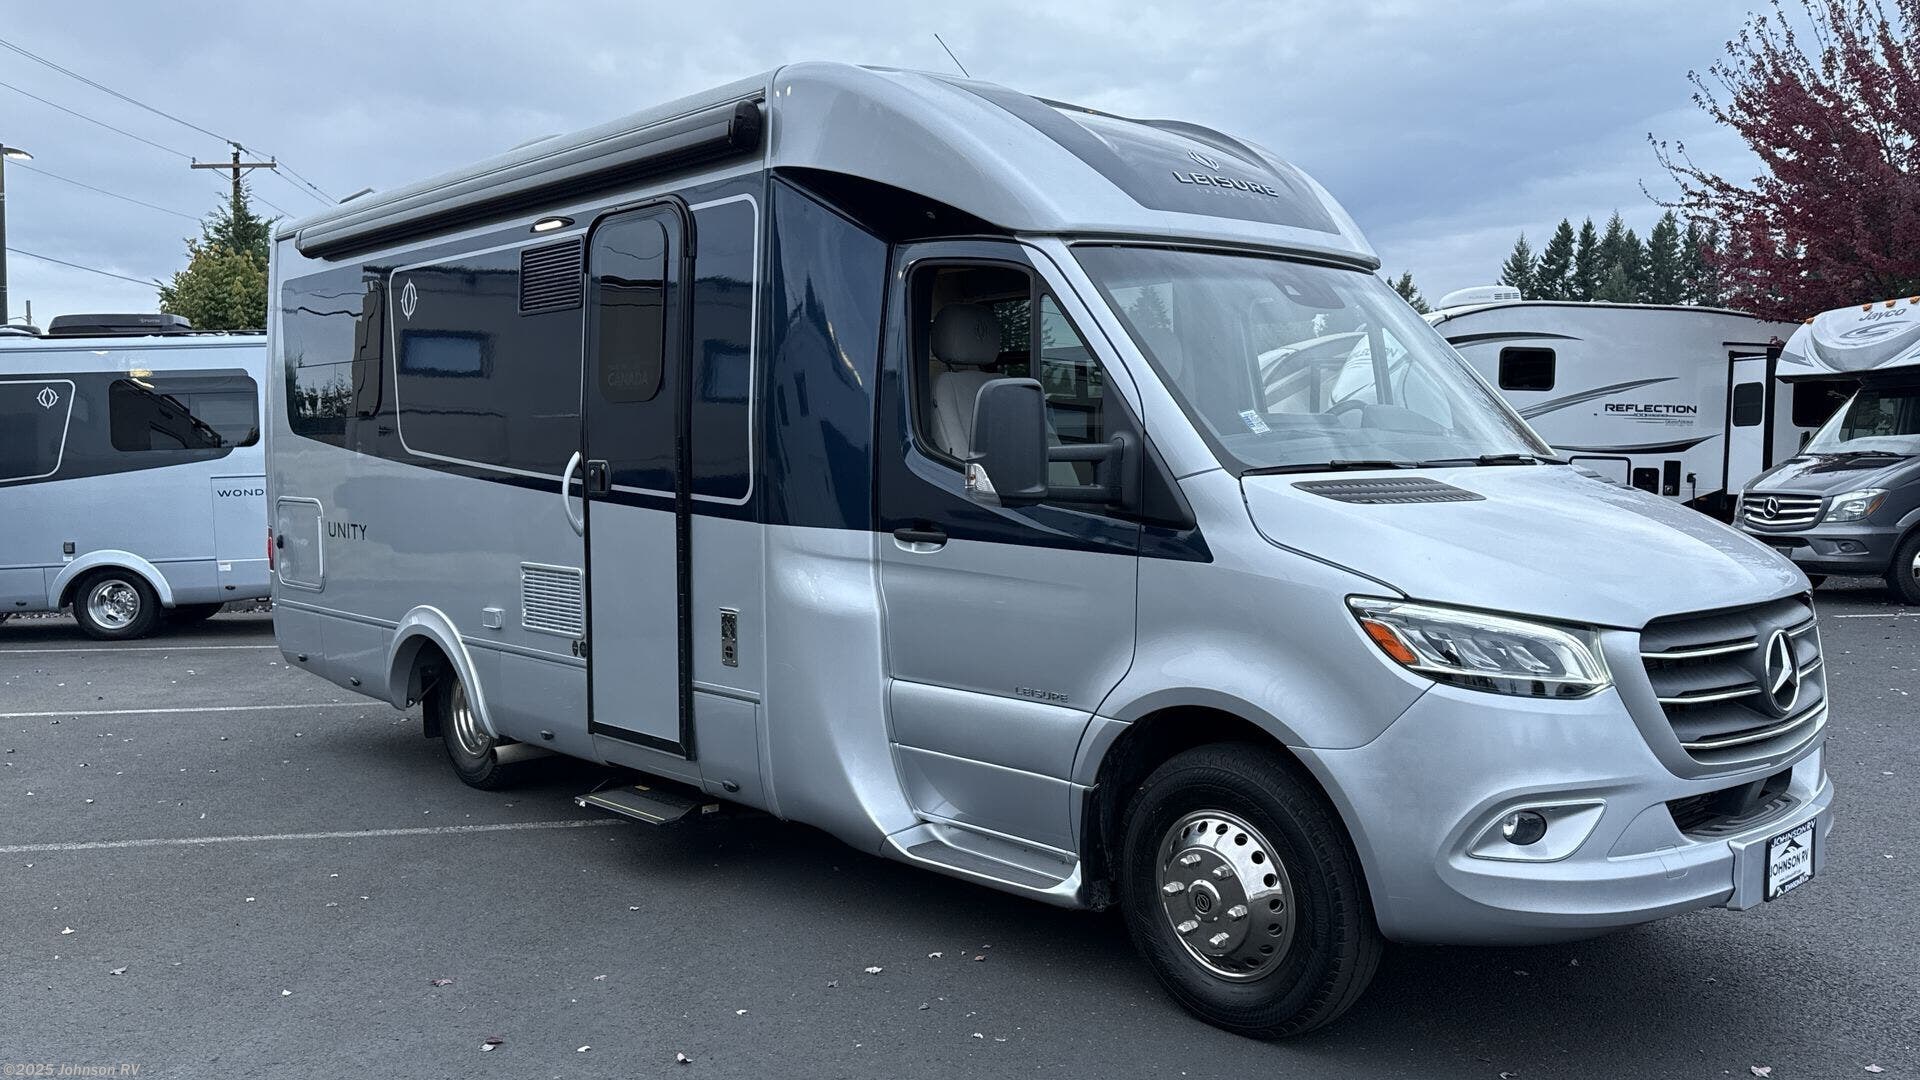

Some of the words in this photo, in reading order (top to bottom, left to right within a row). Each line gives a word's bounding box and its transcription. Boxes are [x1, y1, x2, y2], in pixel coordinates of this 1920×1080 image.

[1172, 170, 1279, 198] LEISURE
[1858, 308, 1907, 322] Jayco
[1604, 403, 1698, 414] REFLECTION
[328, 521, 367, 541] UNITY
[1015, 686, 1070, 704] LEISURE
[1769, 853, 1801, 878] JOHNSON
[1801, 848, 1809, 863] RV
